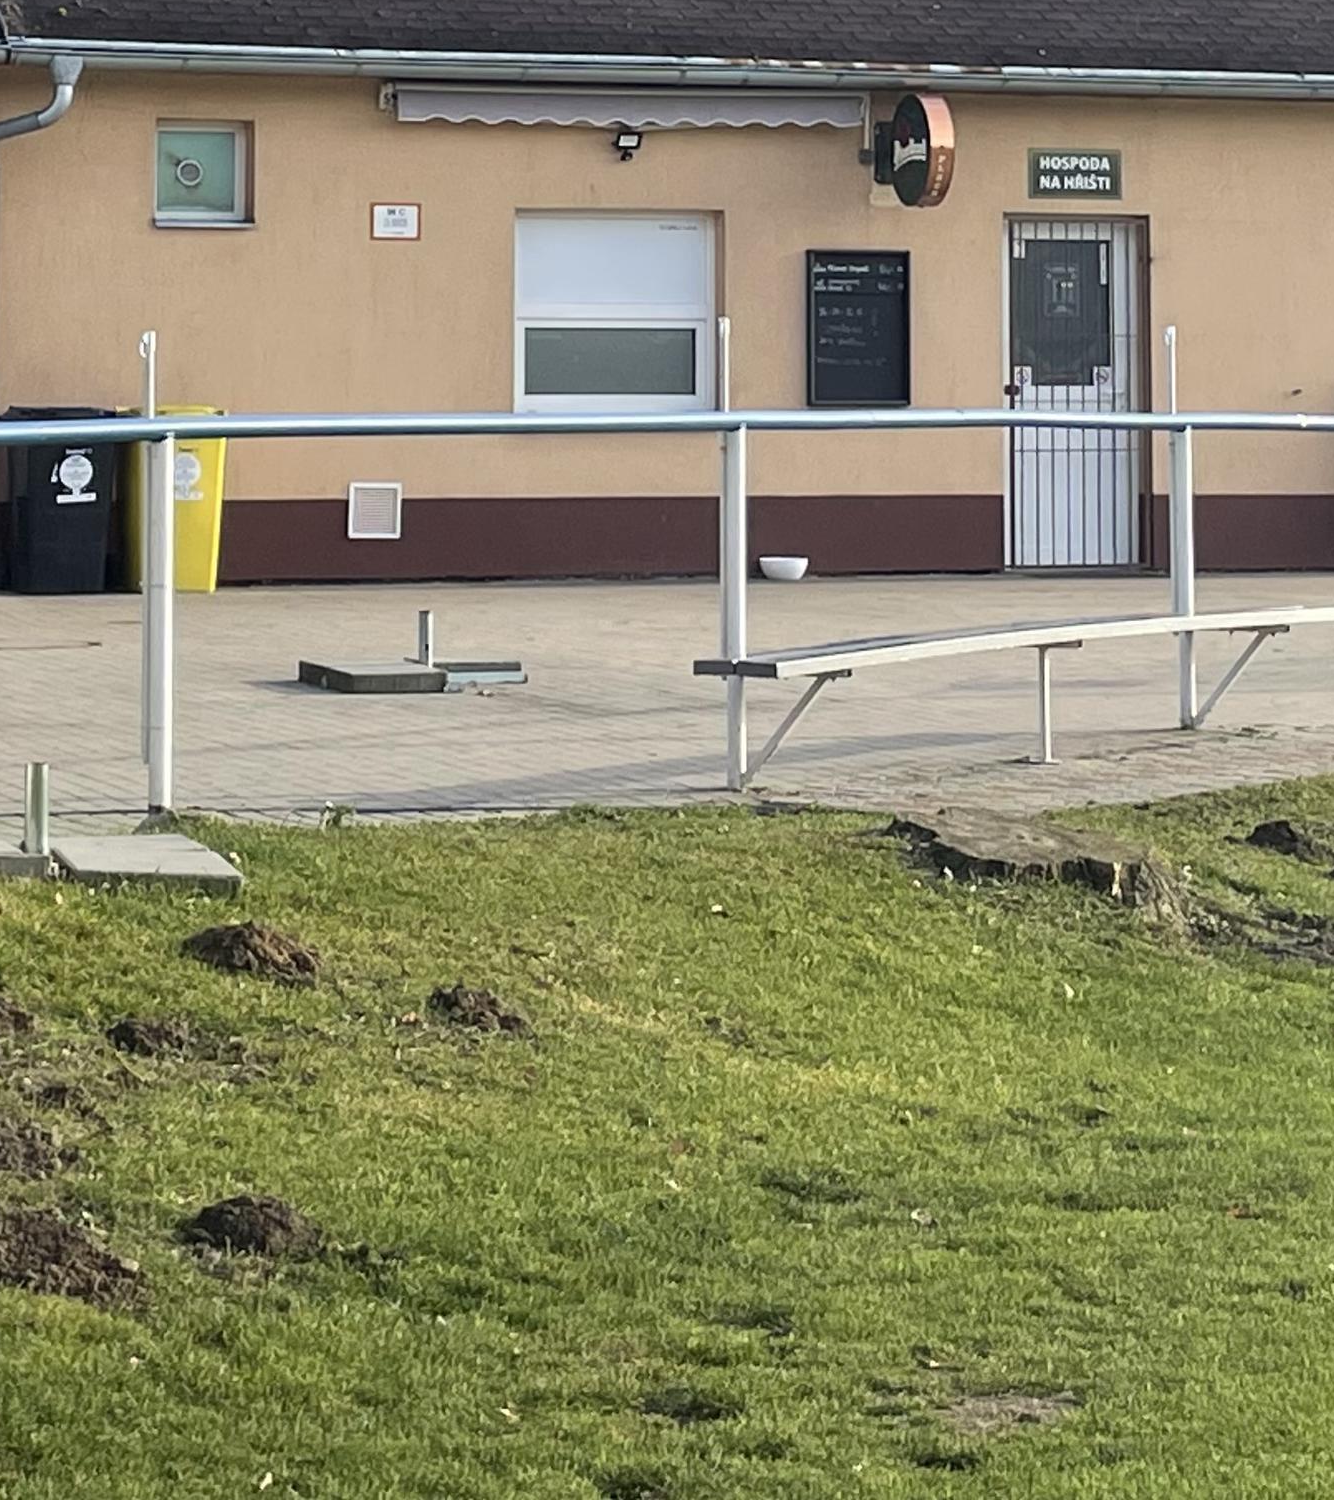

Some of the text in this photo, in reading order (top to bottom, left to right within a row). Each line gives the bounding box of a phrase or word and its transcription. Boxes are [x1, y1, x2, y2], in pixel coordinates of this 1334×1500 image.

[1039, 156, 1111, 171] HOSPODA
[1039, 173, 1111, 190] NA HŘIŠTI
